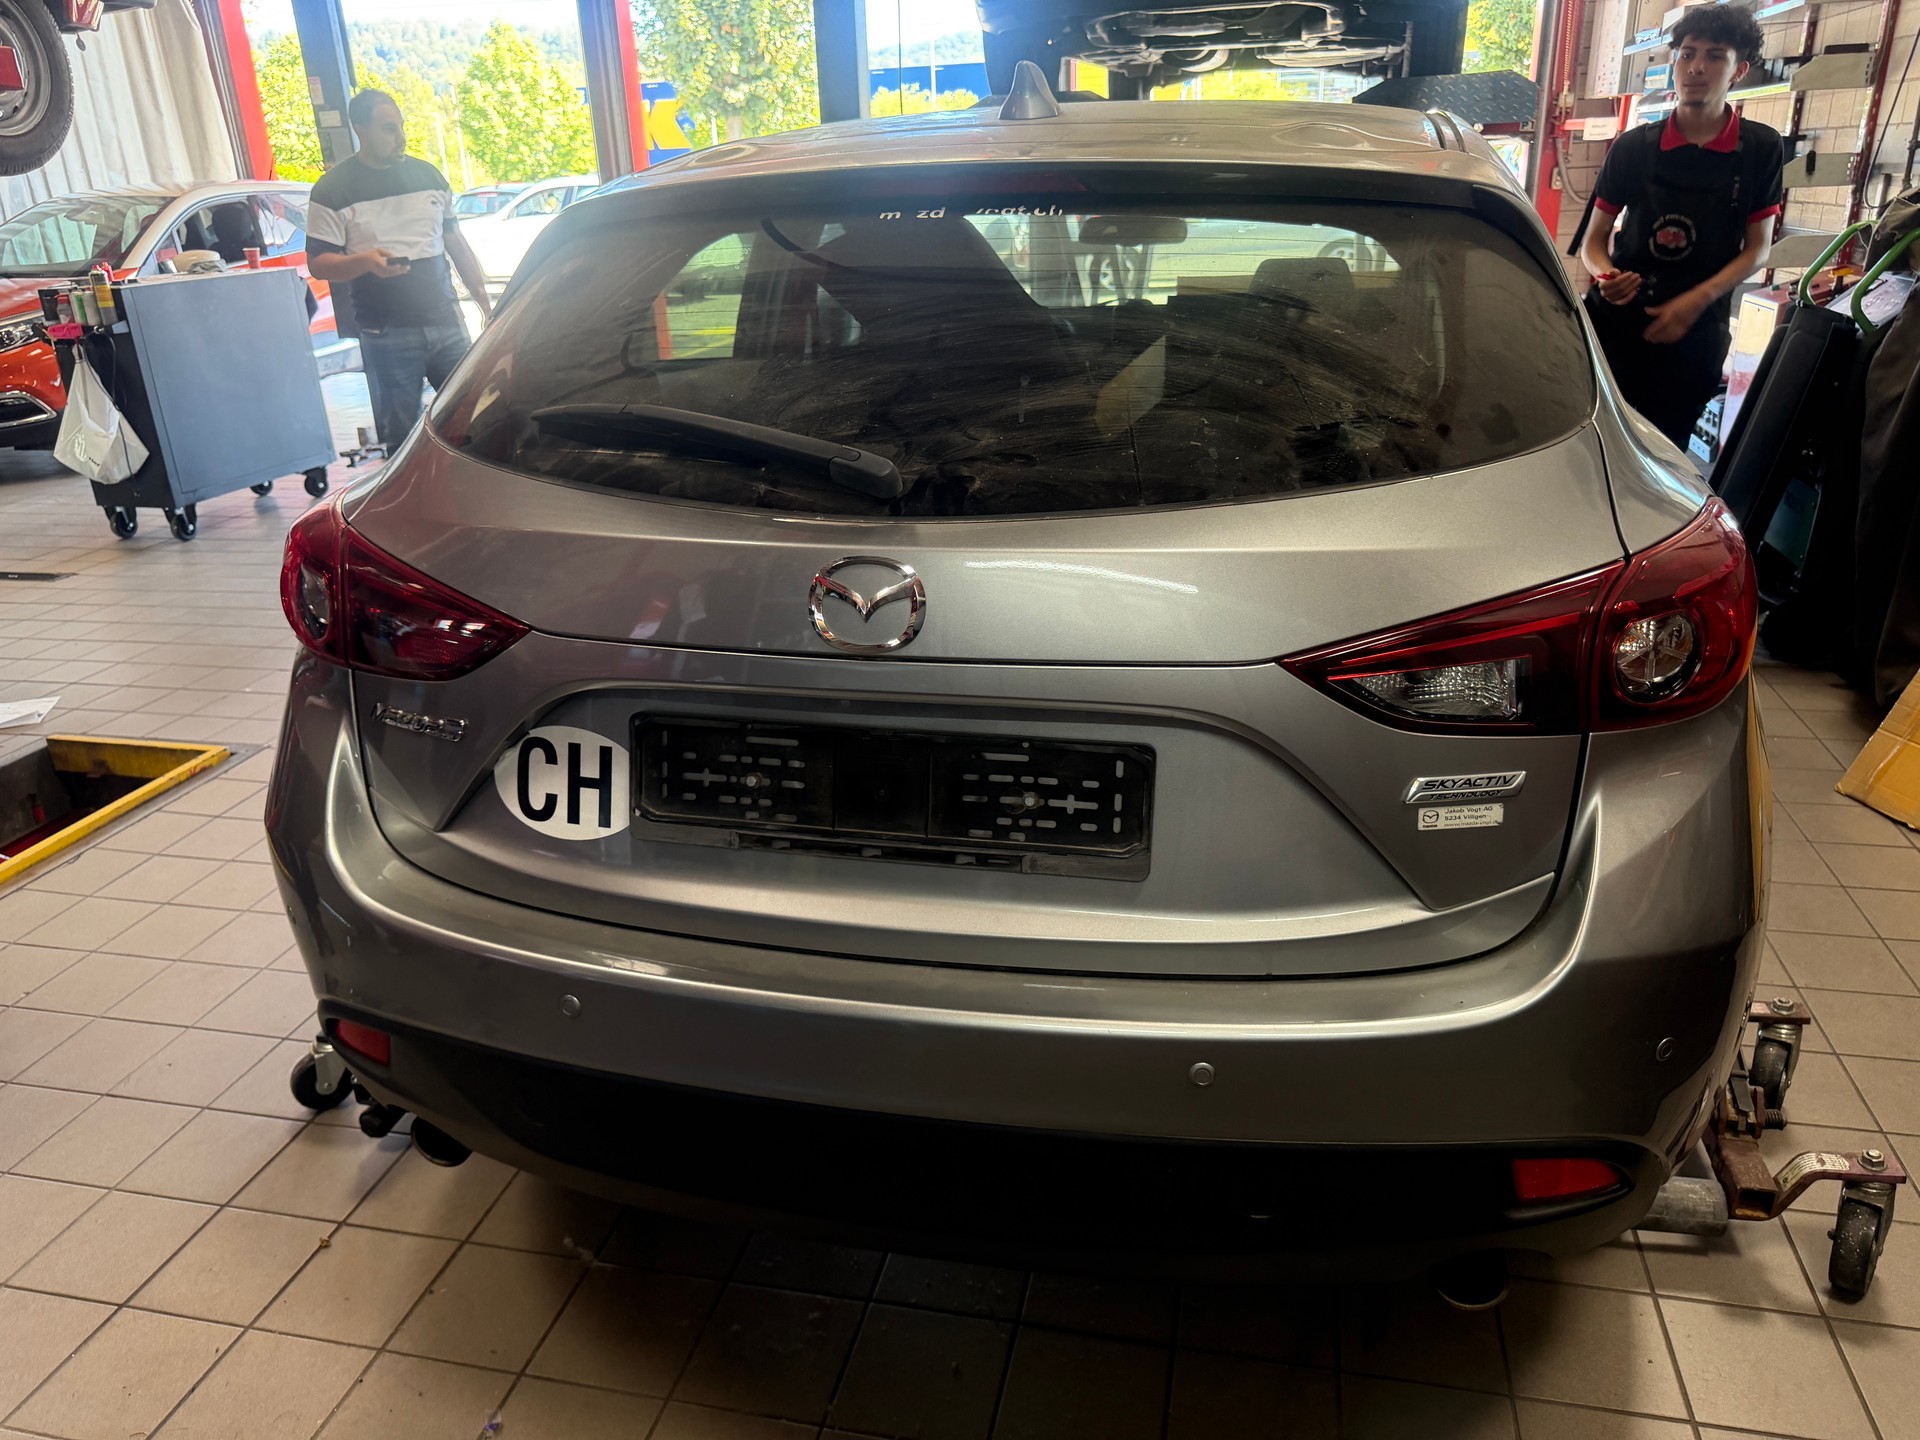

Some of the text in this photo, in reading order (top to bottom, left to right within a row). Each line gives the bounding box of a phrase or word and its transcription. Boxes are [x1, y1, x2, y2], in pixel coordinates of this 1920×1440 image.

[517, 736, 613, 828] CH
[1422, 775, 1516, 790] SKYACTIV
[1430, 789, 1503, 800] TECHNOLOGY
[1463, 813, 1487, 821] Villigen
